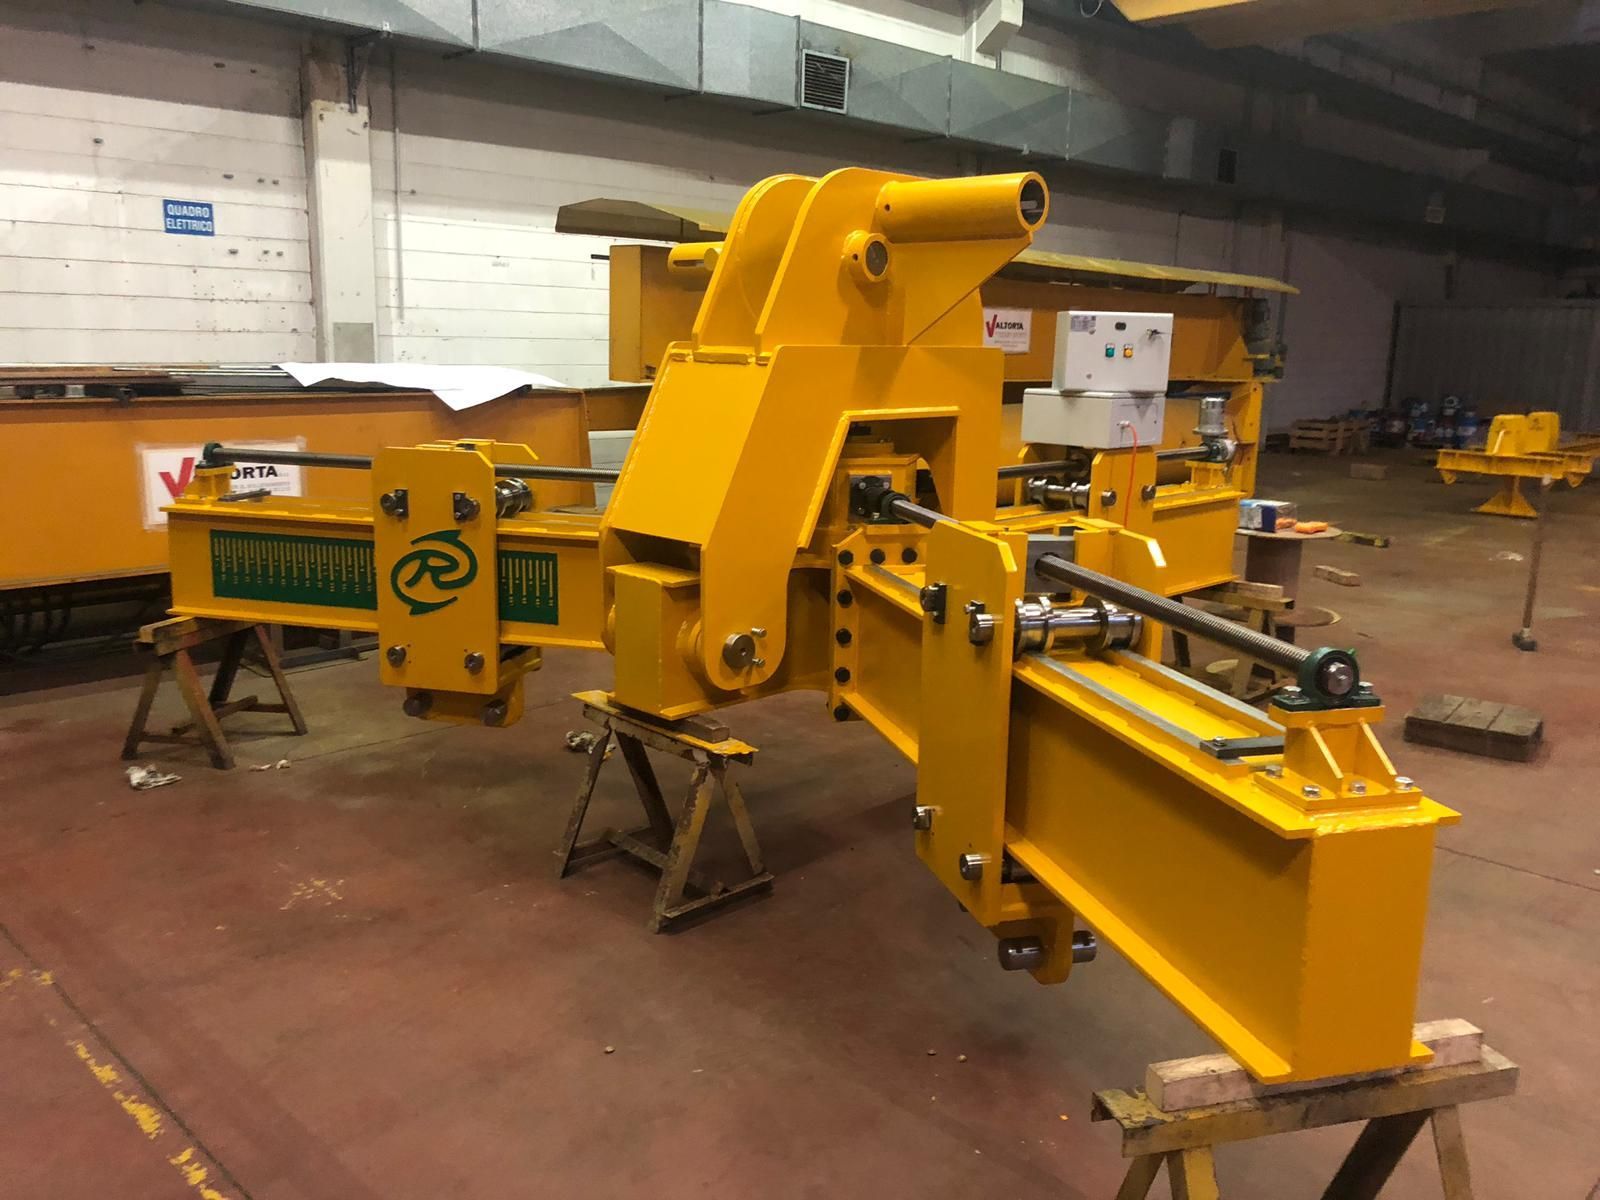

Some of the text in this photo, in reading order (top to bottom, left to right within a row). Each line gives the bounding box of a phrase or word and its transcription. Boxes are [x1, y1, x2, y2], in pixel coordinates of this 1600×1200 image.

[167, 204, 209, 218] QUADRO
[166, 218, 212, 232] ELETTRICO
[986, 314, 1024, 338] VALTORTA
